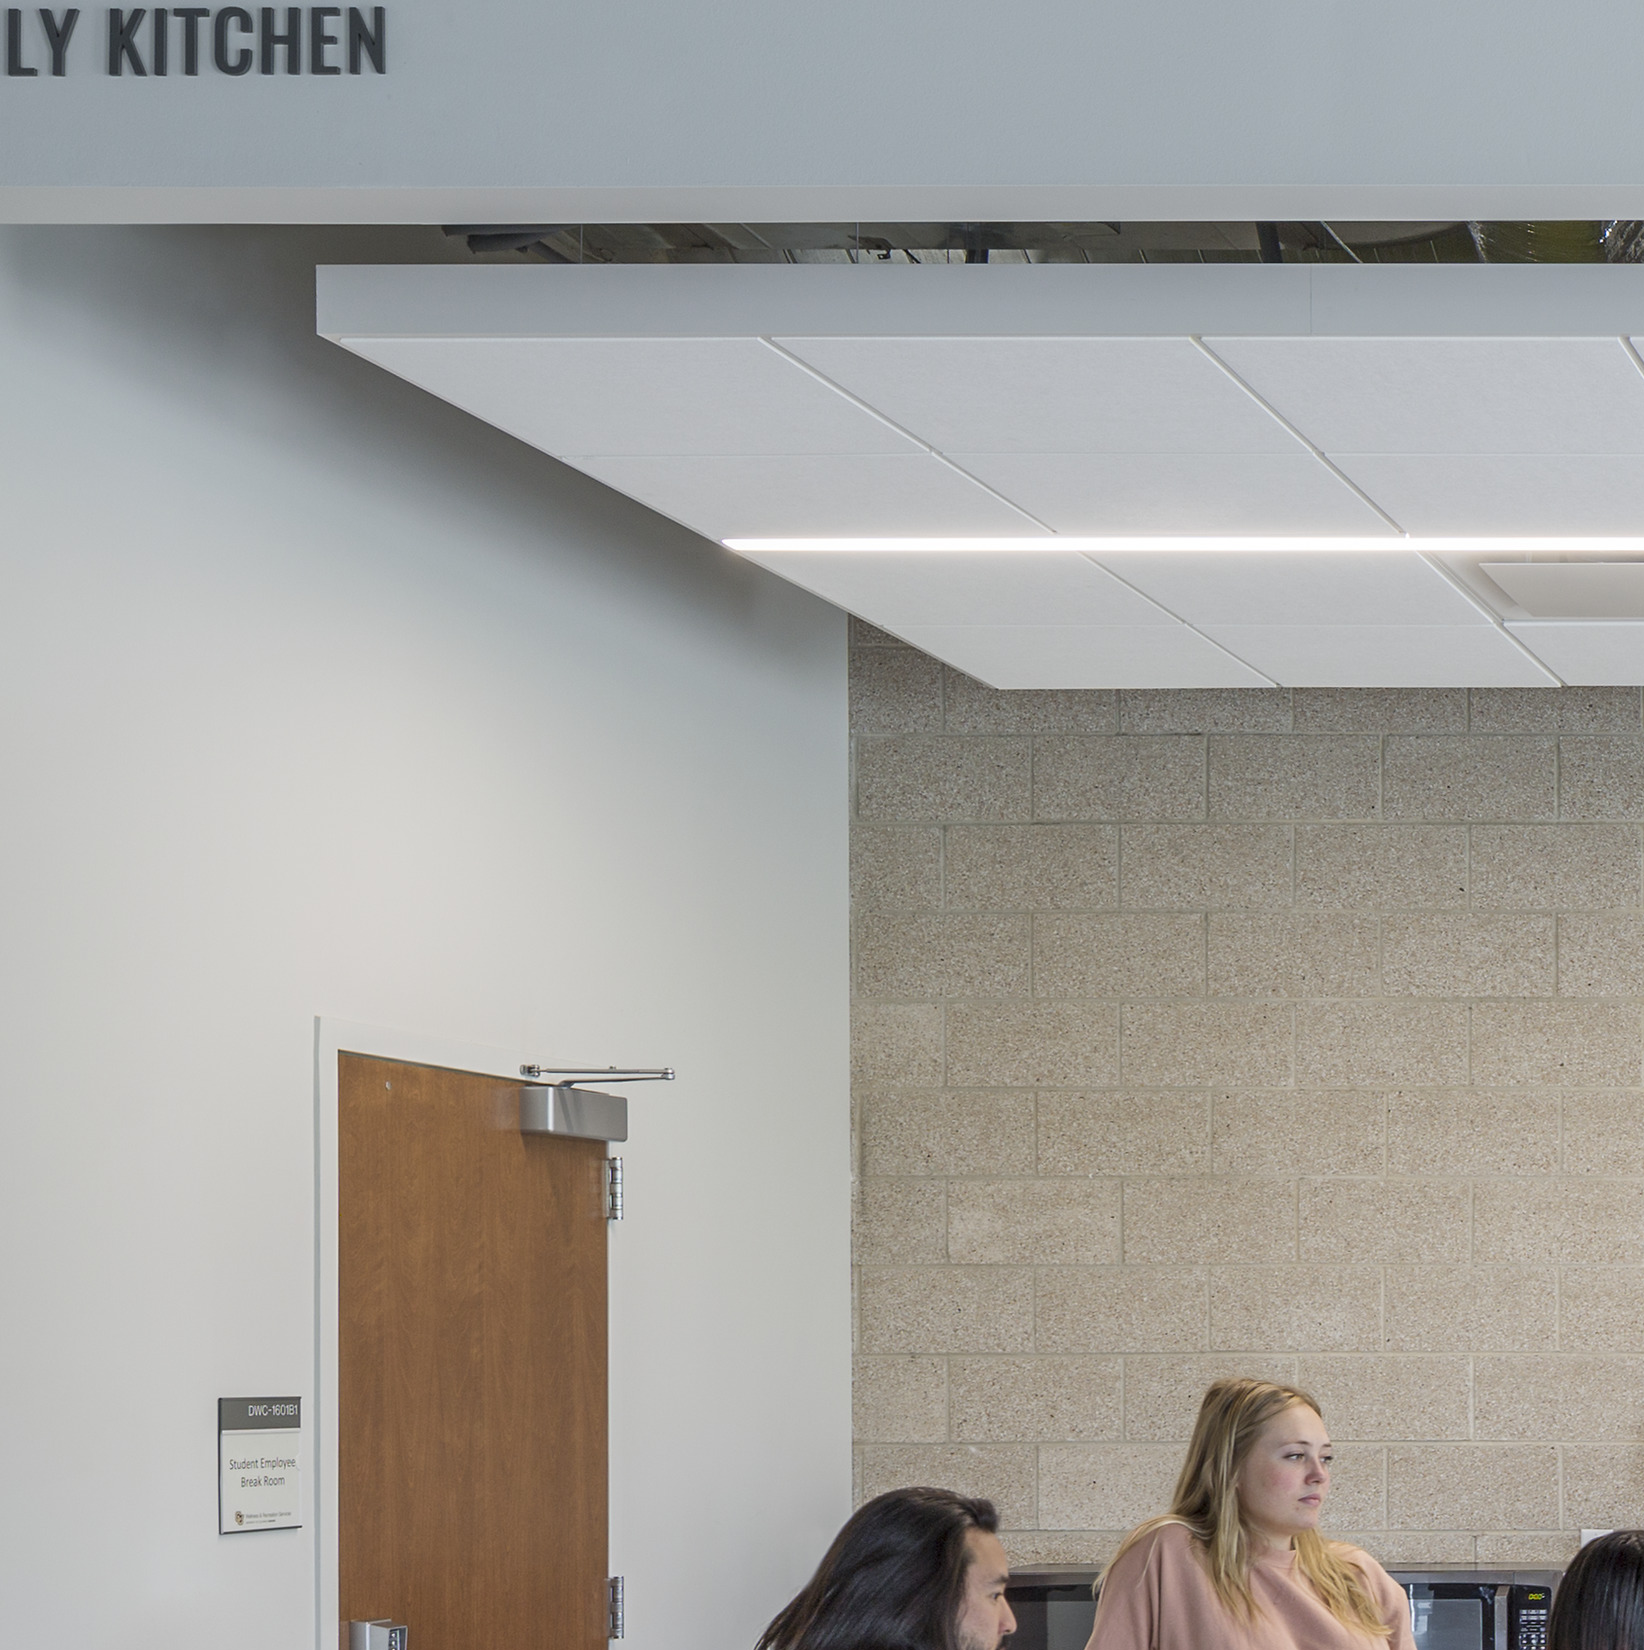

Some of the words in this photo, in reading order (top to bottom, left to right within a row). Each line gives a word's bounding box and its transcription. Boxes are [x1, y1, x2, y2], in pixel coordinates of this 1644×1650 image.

[8, 8, 81, 76] LY
[108, 6, 387, 76] KITCHEN
[247, 1404, 298, 1416] DWC-1601B1
[229, 1457, 259, 1470] Student
[260, 1457, 296, 1470] Employee
[241, 1476, 262, 1488] Break
[263, 1475, 285, 1486] Room
